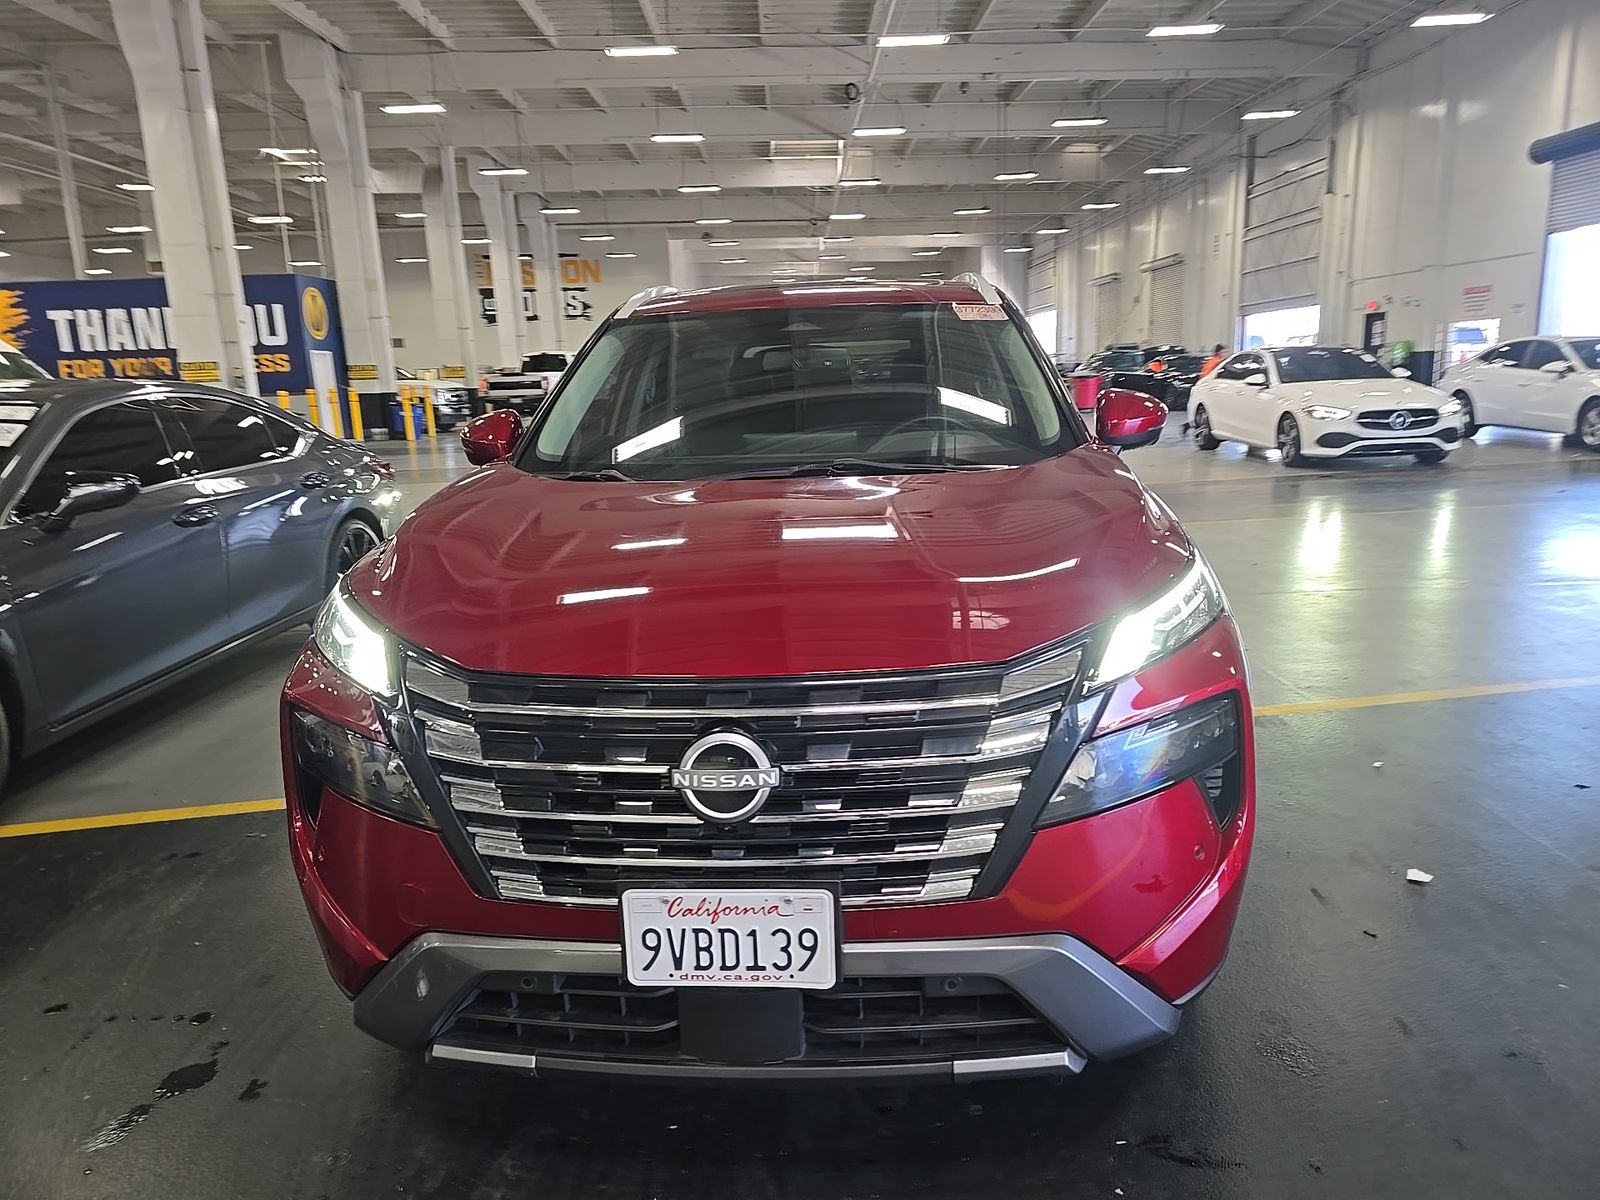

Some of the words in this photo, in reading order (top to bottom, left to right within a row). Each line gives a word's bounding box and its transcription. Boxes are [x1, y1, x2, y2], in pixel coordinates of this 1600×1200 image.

[57, 359, 106, 379] FOR
[673, 772, 776, 788] NISSAN
[667, 896, 794, 924] California
[641, 928, 819, 972] 9VBD139
[679, 973, 783, 982] dmv.ca.gov
